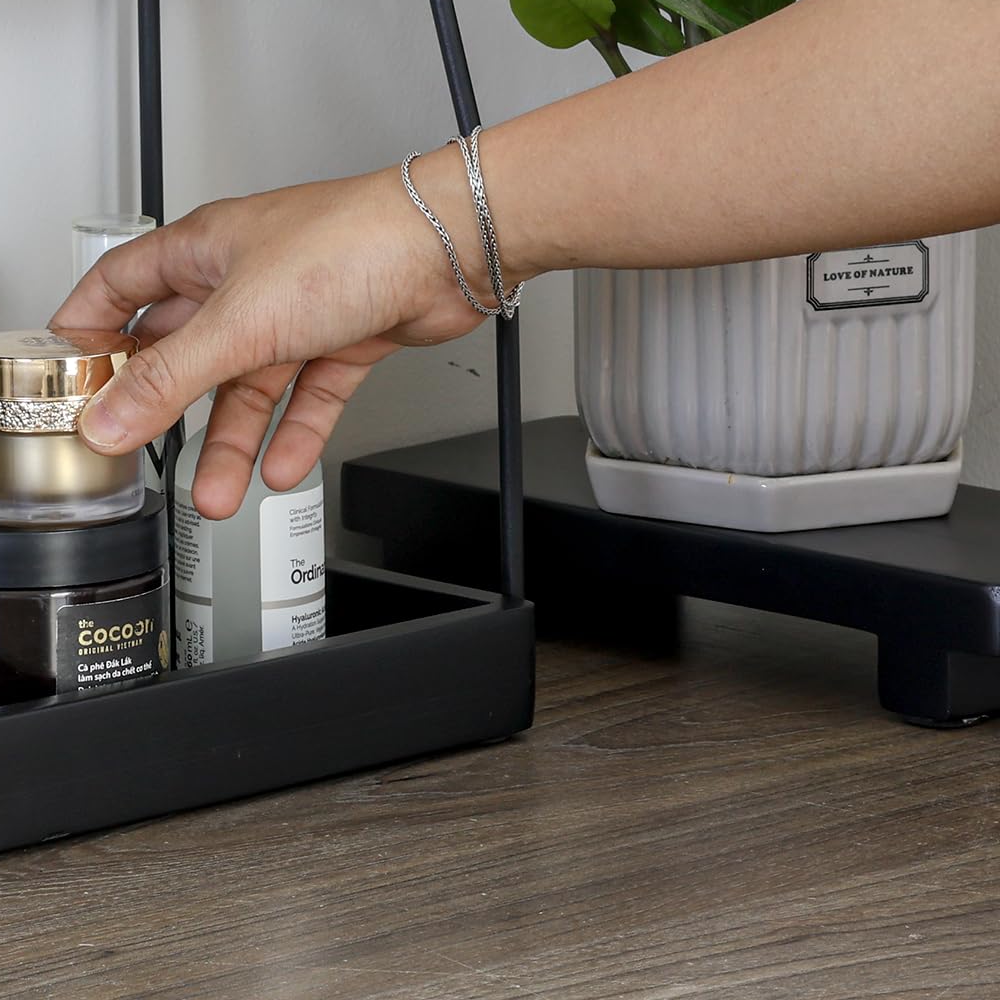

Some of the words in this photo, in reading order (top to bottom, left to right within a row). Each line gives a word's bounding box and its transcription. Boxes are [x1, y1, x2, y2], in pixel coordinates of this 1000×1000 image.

[823, 271, 852, 282] LOVE
[853, 269, 868, 279] OF
[869, 266, 914, 277] NATURE
[290, 558, 305, 567] The
[291, 560, 325, 584] Ordina
[78, 619, 94, 629] the
[78, 645, 113, 656] ORIGINAL
[112, 670, 121, 678] da
